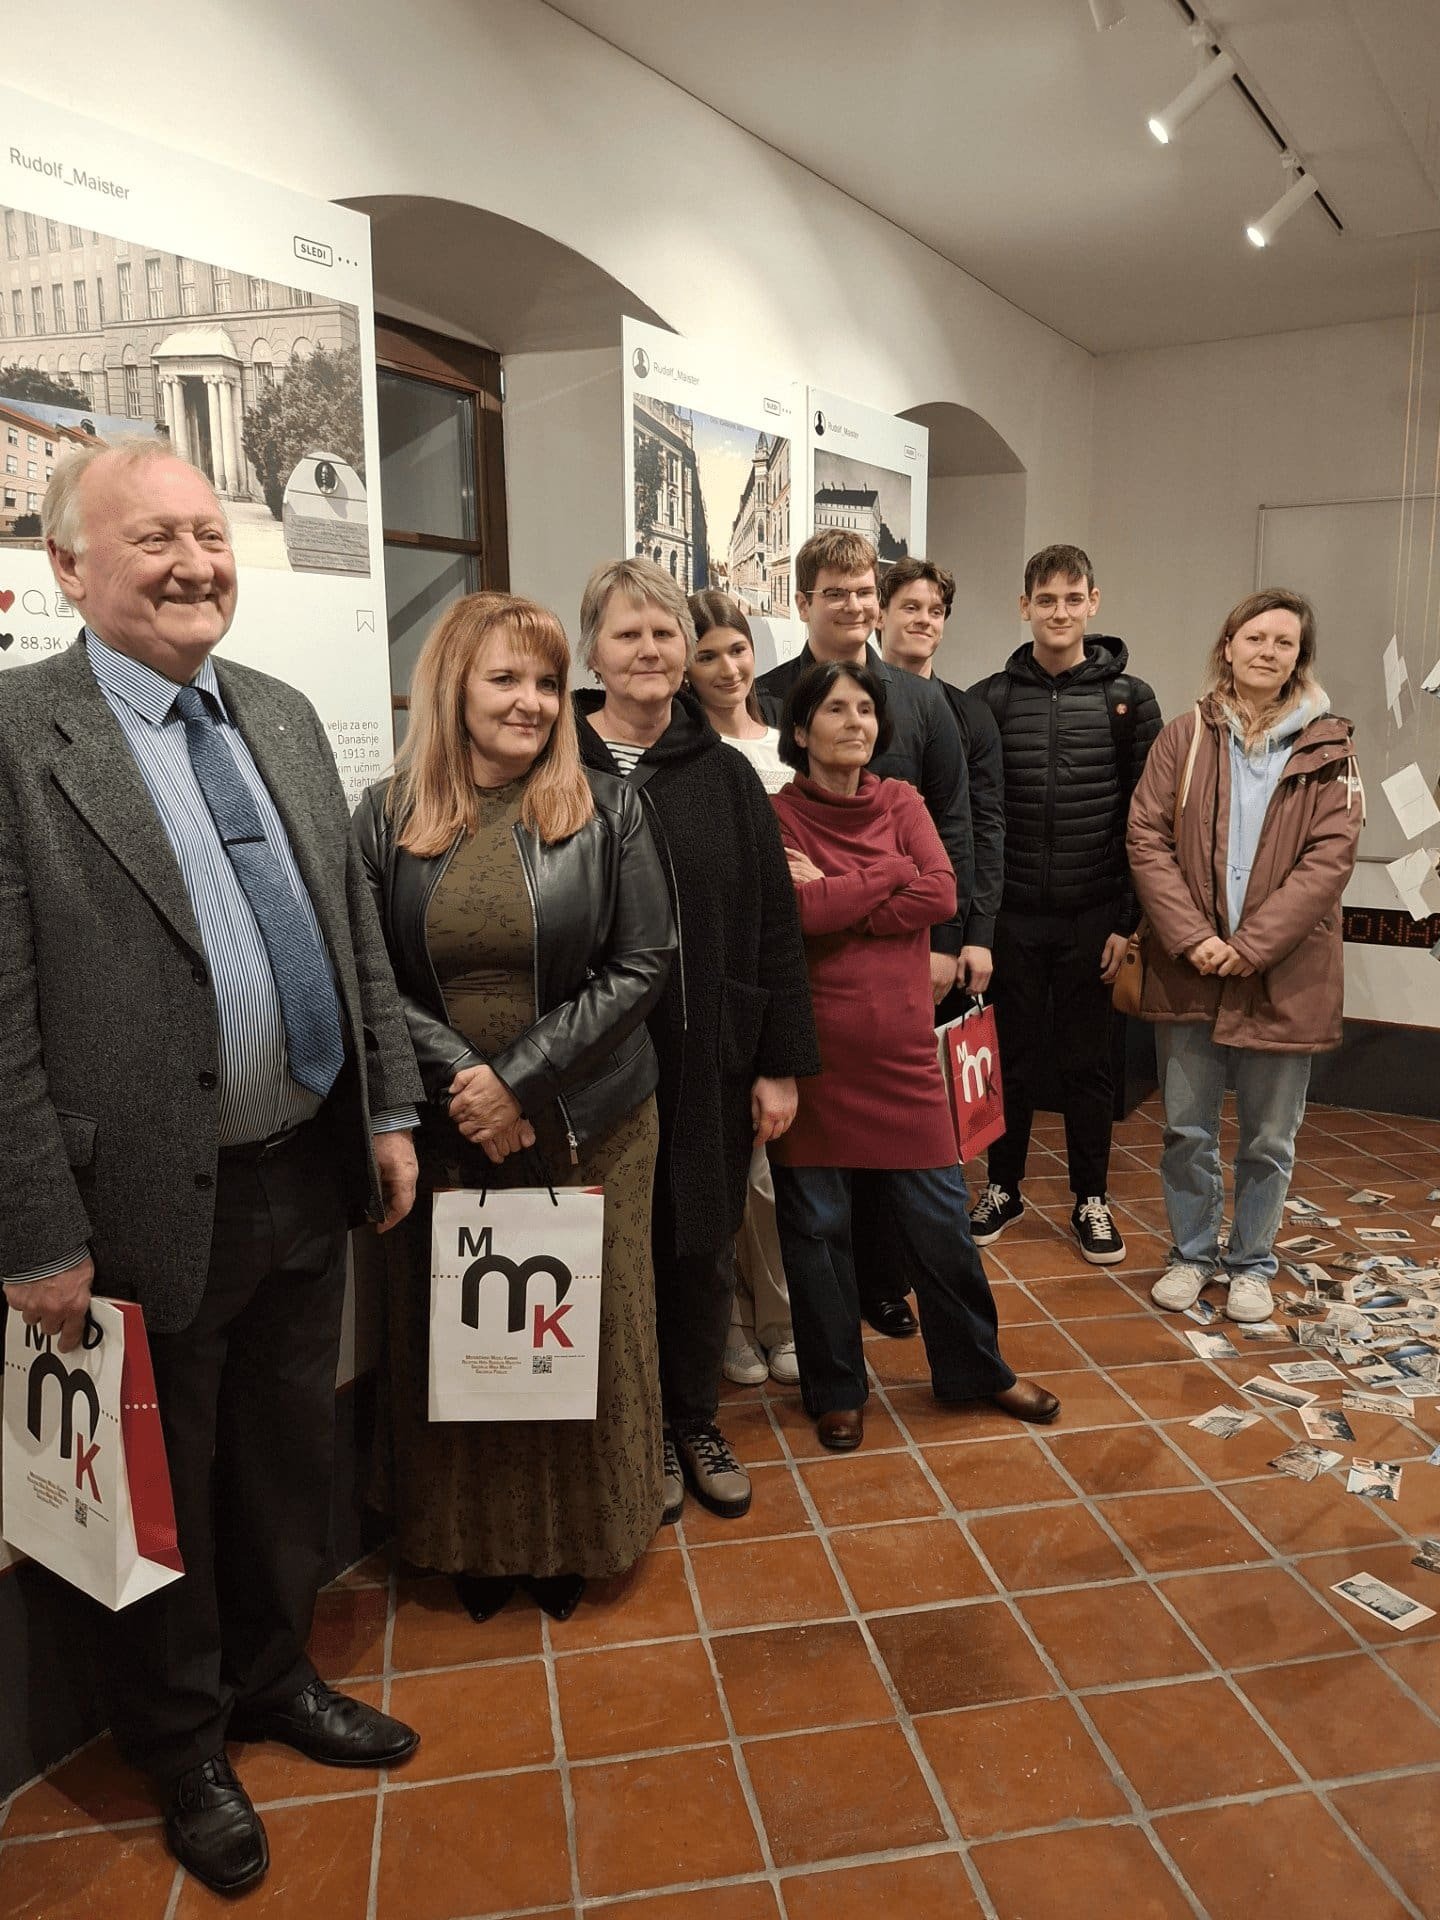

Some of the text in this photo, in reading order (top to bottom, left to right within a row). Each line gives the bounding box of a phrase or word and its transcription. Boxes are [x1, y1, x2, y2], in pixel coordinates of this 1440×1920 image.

[9, 147, 130, 200] Rudolf_Maister
[301, 243, 326, 260] SLEDI
[20, 636, 61, 651] 88,3K
[350, 721, 360, 730] za
[362, 721, 379, 730] eno
[337, 734, 379, 746] Današnje
[342, 748, 366, 759] 1913
[369, 750, 380, 758] na
[354, 763, 380, 773] učnim
[458, 1227, 493, 1257] M
[533, 1304, 574, 1349] K
